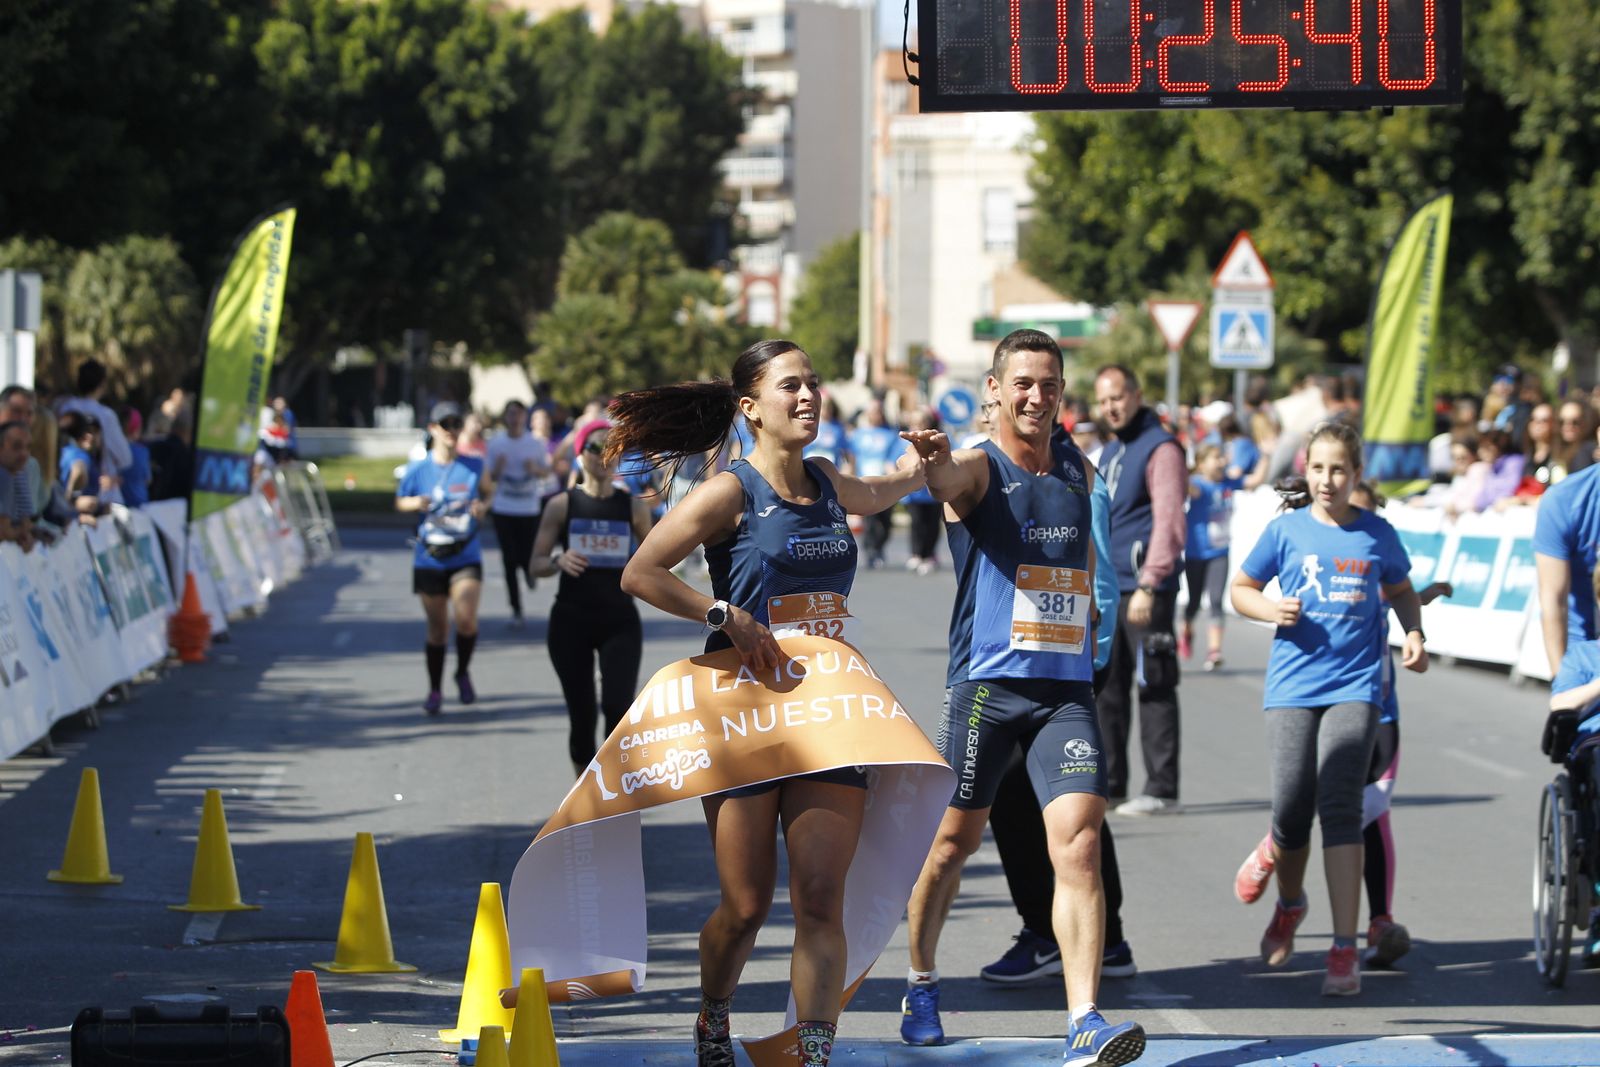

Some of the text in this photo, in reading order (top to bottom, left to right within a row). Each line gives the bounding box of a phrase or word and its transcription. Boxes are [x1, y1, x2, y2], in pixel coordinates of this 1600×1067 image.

[1028, 526, 1078, 540] DEHARO
[796, 539, 848, 557] DEHARO
[1038, 591, 1076, 615] 381
[711, 665, 760, 693] LA
[720, 694, 914, 741] NUESTRA
[619, 719, 706, 750] CARRERA
[621, 748, 711, 794] mujer
